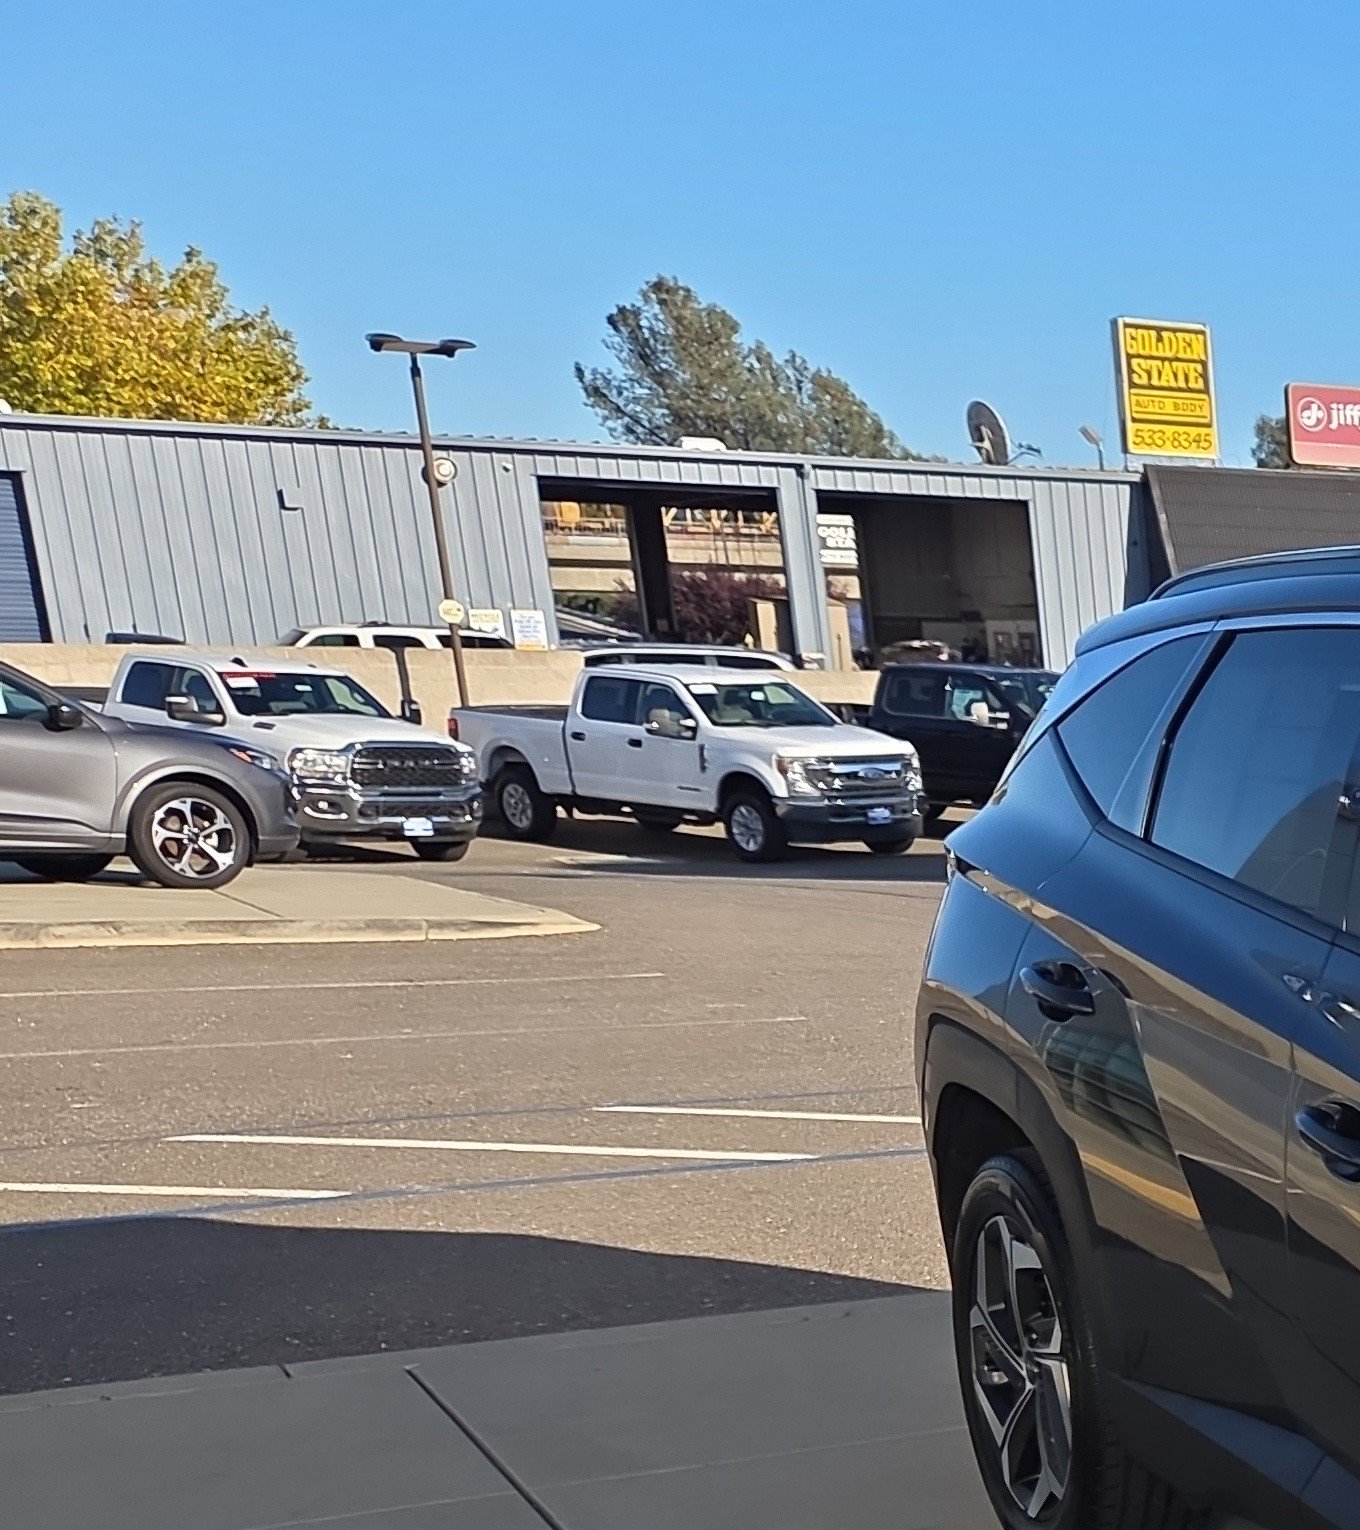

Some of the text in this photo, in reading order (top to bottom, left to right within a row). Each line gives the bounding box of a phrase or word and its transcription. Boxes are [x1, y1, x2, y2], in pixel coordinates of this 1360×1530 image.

[1124, 328, 1207, 360] GOLDEN
[1131, 358, 1205, 389] STATE
[1134, 399, 1205, 413] AUTO BODY
